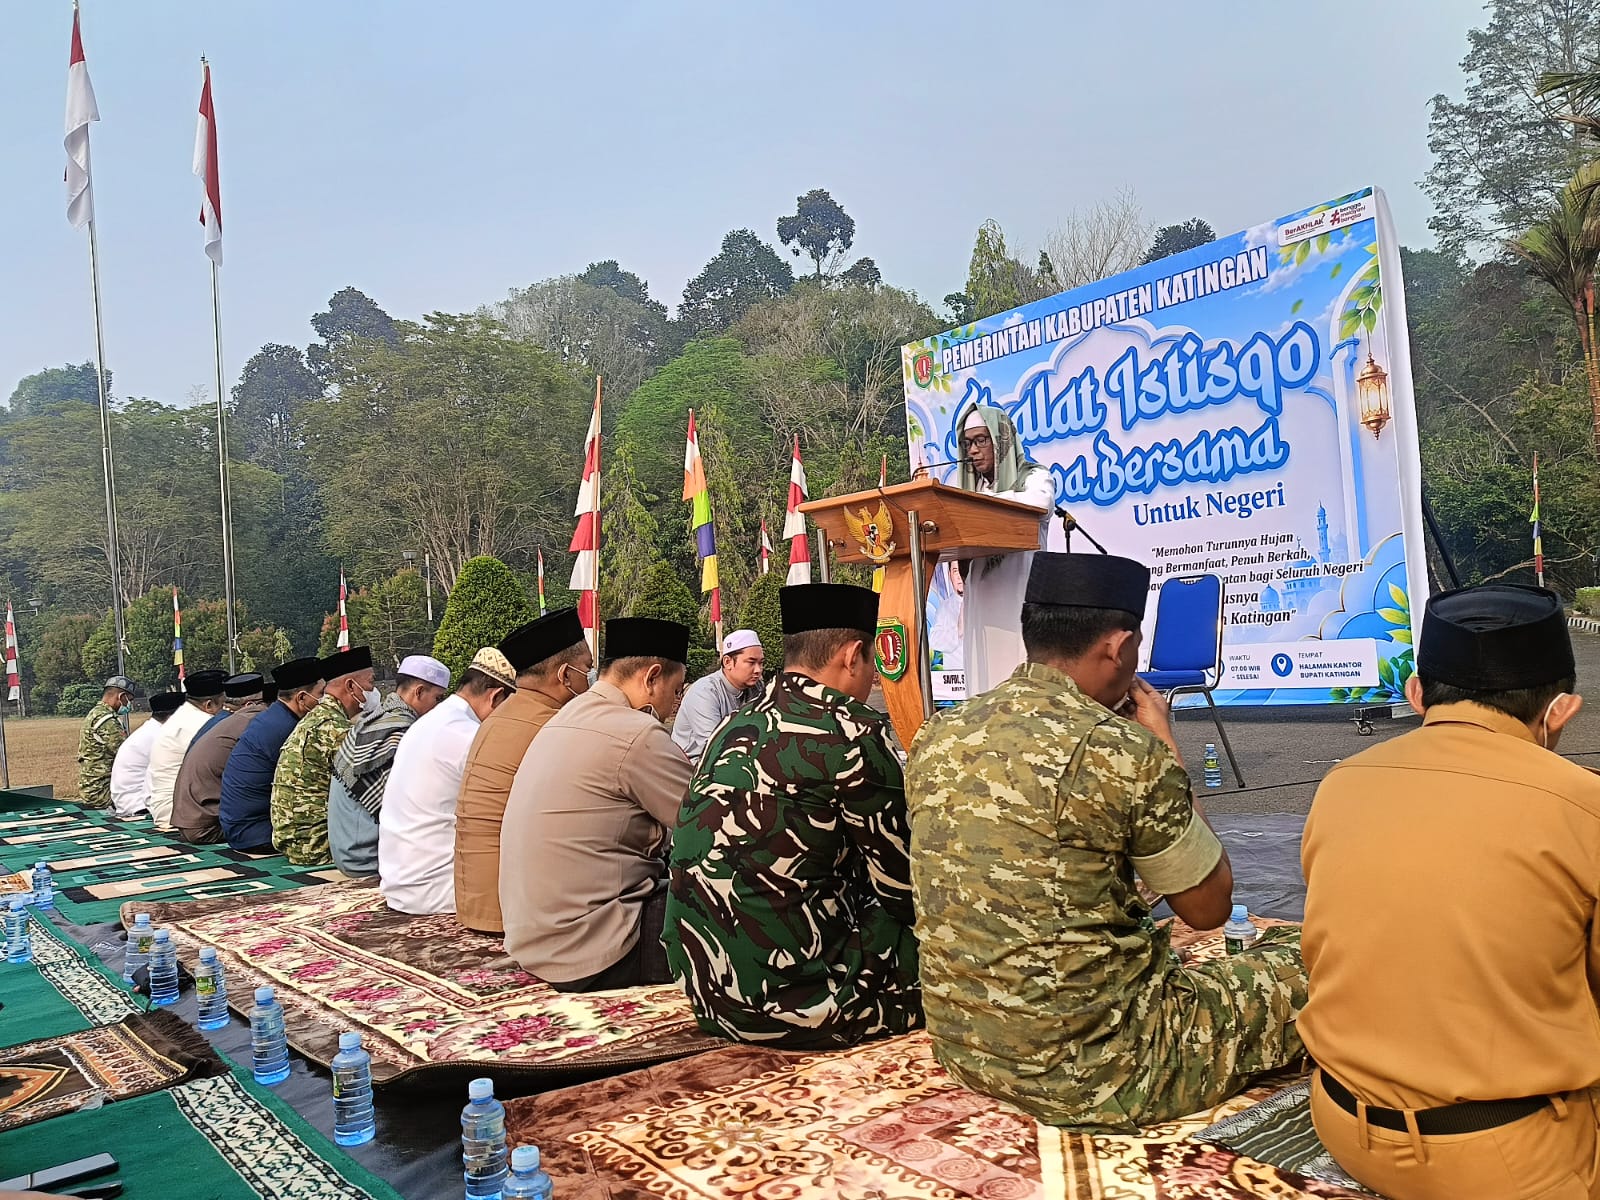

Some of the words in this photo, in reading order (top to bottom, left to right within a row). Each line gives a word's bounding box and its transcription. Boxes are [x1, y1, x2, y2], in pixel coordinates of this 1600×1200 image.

[1284, 216, 1325, 235] BerAKHLAK
[941, 322, 1041, 374] PEMERINTAH
[1044, 282, 1152, 344] KABUPATEN
[1156, 246, 1268, 310] KATINGAN
[1104, 320, 1320, 432] Istisqo
[1092, 416, 1290, 506] Bersama
[1133, 494, 1202, 526] Untuk
[1205, 482, 1286, 519] Negeri
[1205, 536, 1257, 553] Turunnya
[1259, 533, 1294, 549] Hujan
[1165, 556, 1229, 574] Bermanfaat,
[1231, 553, 1264, 568] Penuh
[1266, 547, 1313, 563] Berkah,
[1249, 568, 1275, 585] bagi
[1276, 563, 1320, 580] Seluruh
[1322, 560, 1364, 577] Negeri
[1325, 670, 1361, 678] KATINGAN
[1333, 661, 1362, 669] KANTOR
